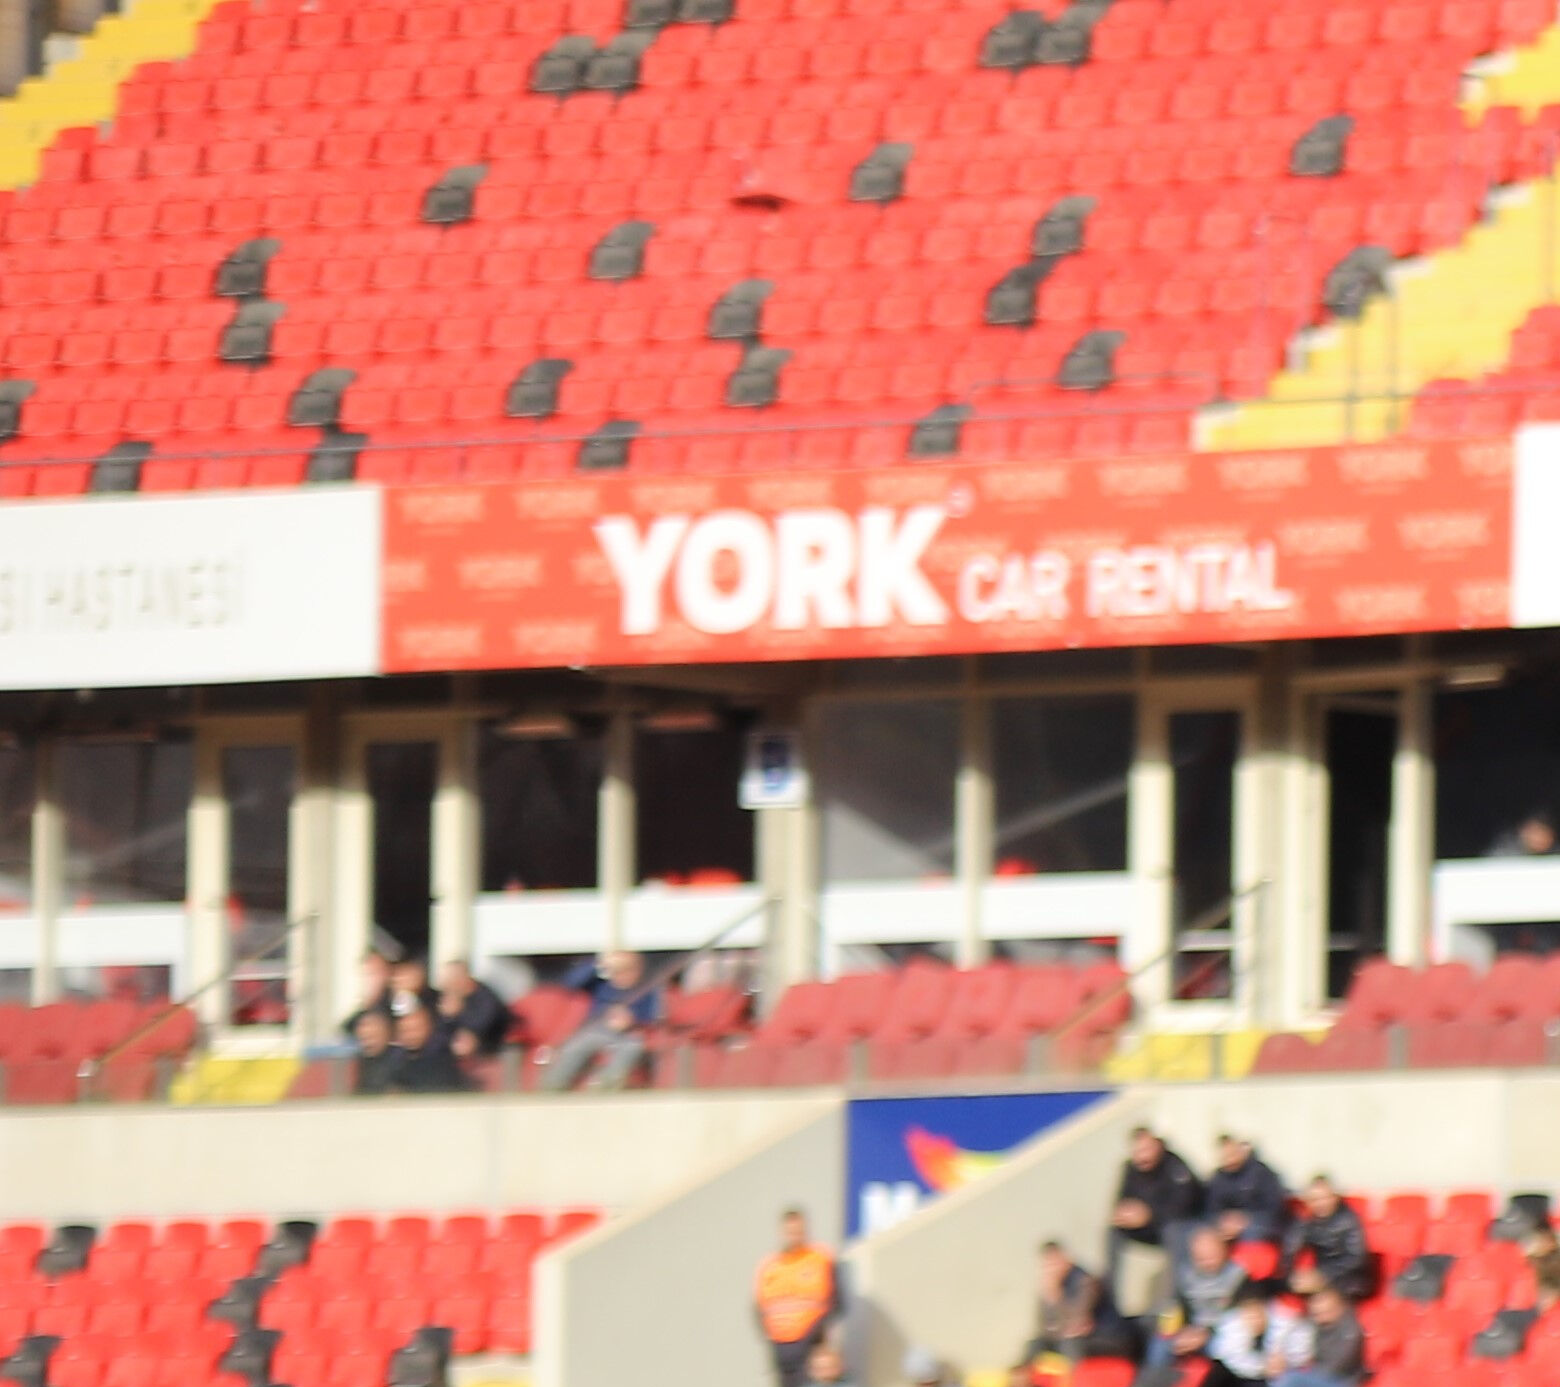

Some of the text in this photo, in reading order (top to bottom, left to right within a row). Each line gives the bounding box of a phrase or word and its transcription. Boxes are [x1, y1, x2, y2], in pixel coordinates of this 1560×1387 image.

[592, 506, 950, 636] YORK
[958, 550, 1069, 624] CAR
[1087, 541, 1295, 621] RENTAL
